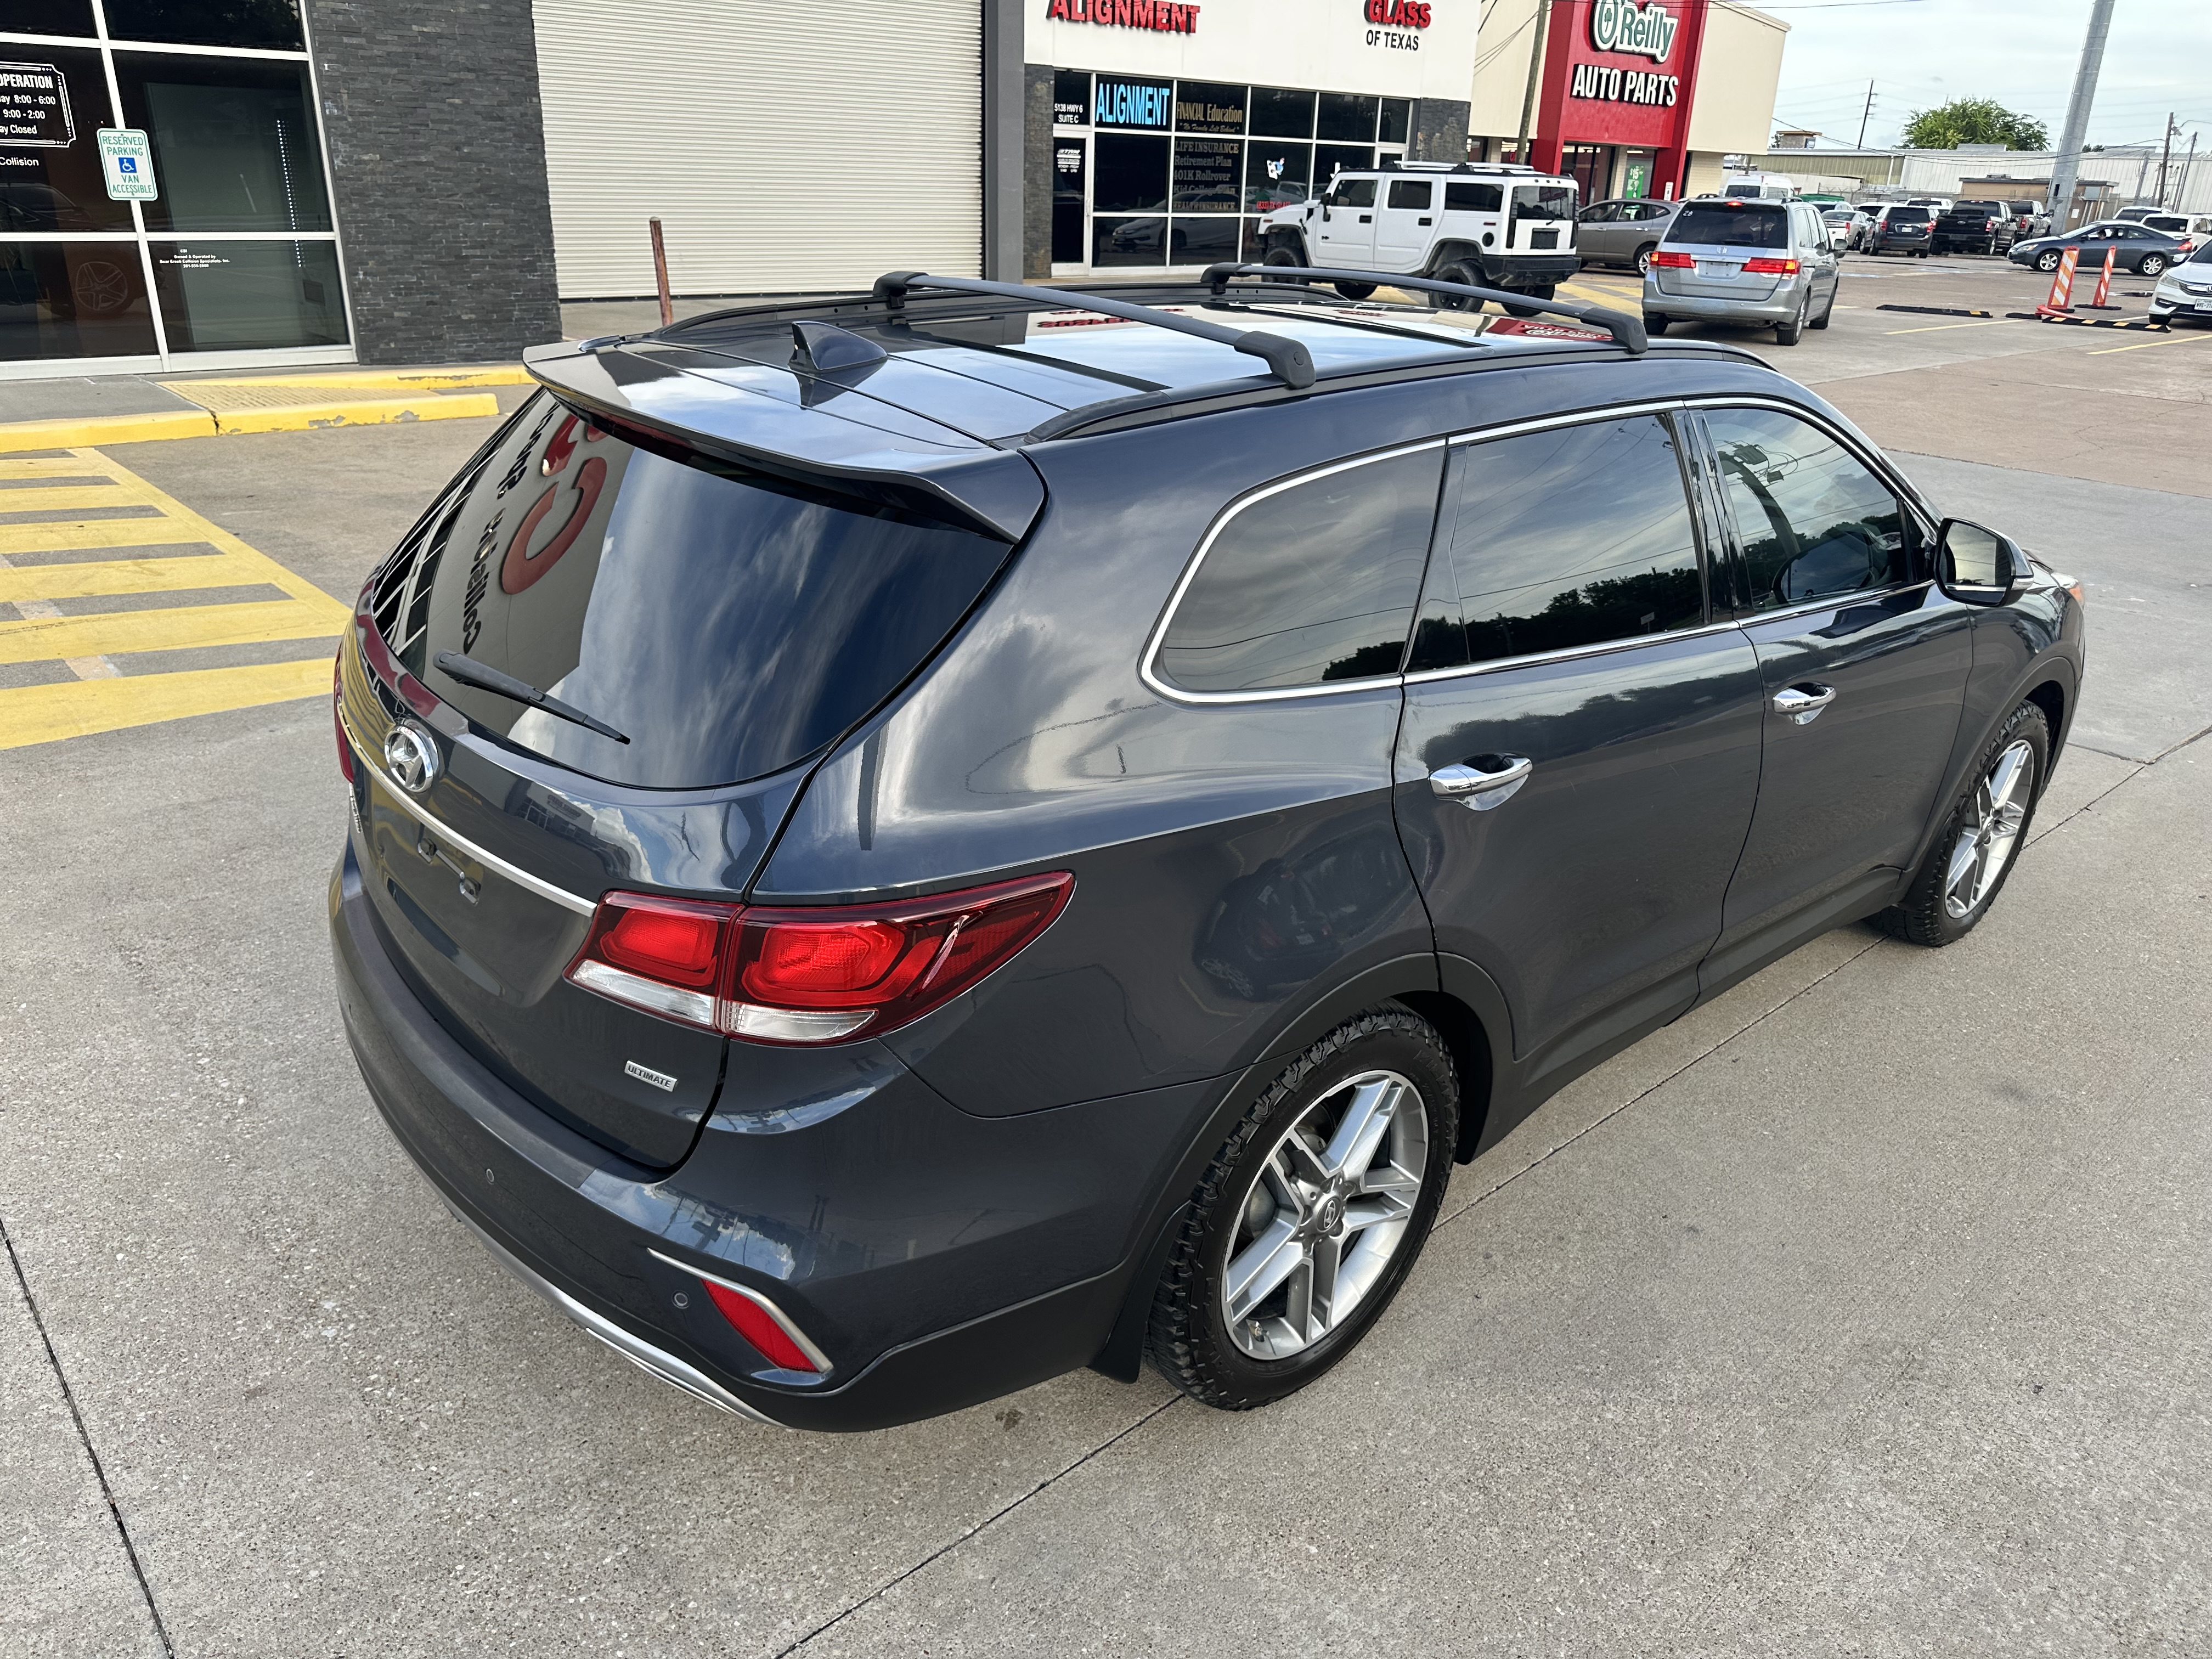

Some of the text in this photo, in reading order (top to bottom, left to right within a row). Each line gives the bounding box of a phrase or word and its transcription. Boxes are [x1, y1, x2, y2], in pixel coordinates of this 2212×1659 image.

[1050, 0, 1200, 33] ALIGNMENT
[1367, 0, 1431, 29] GLASS
[1366, 30, 1419, 51] OF TEXAS
[1572, 64, 1679, 106] AUTO PARTS
[14, 94, 32, 104] 8:00
[38, 96, 56, 105] 6:00
[1096, 83, 1170, 126] ALIGNMENT
[3, 109, 21, 119] 9:00
[28, 110, 46, 119] 2:00
[1058, 114, 1079, 123] SUITE C
[1207, 104, 1243, 123] Education
[10, 124, 37, 134] Closed
[102, 136, 144, 145] RESERVED
[106, 146, 144, 156] PARKING
[1175, 140, 1239, 154] LIFE INSURANCE
[0, 156, 39, 166] Collision
[1175, 155, 1232, 167] Retirement Plan
[121, 174, 139, 184] VAN
[112, 184, 153, 194] ACCESSIBLE
[628, 1065, 672, 1088] ULTIMATE
